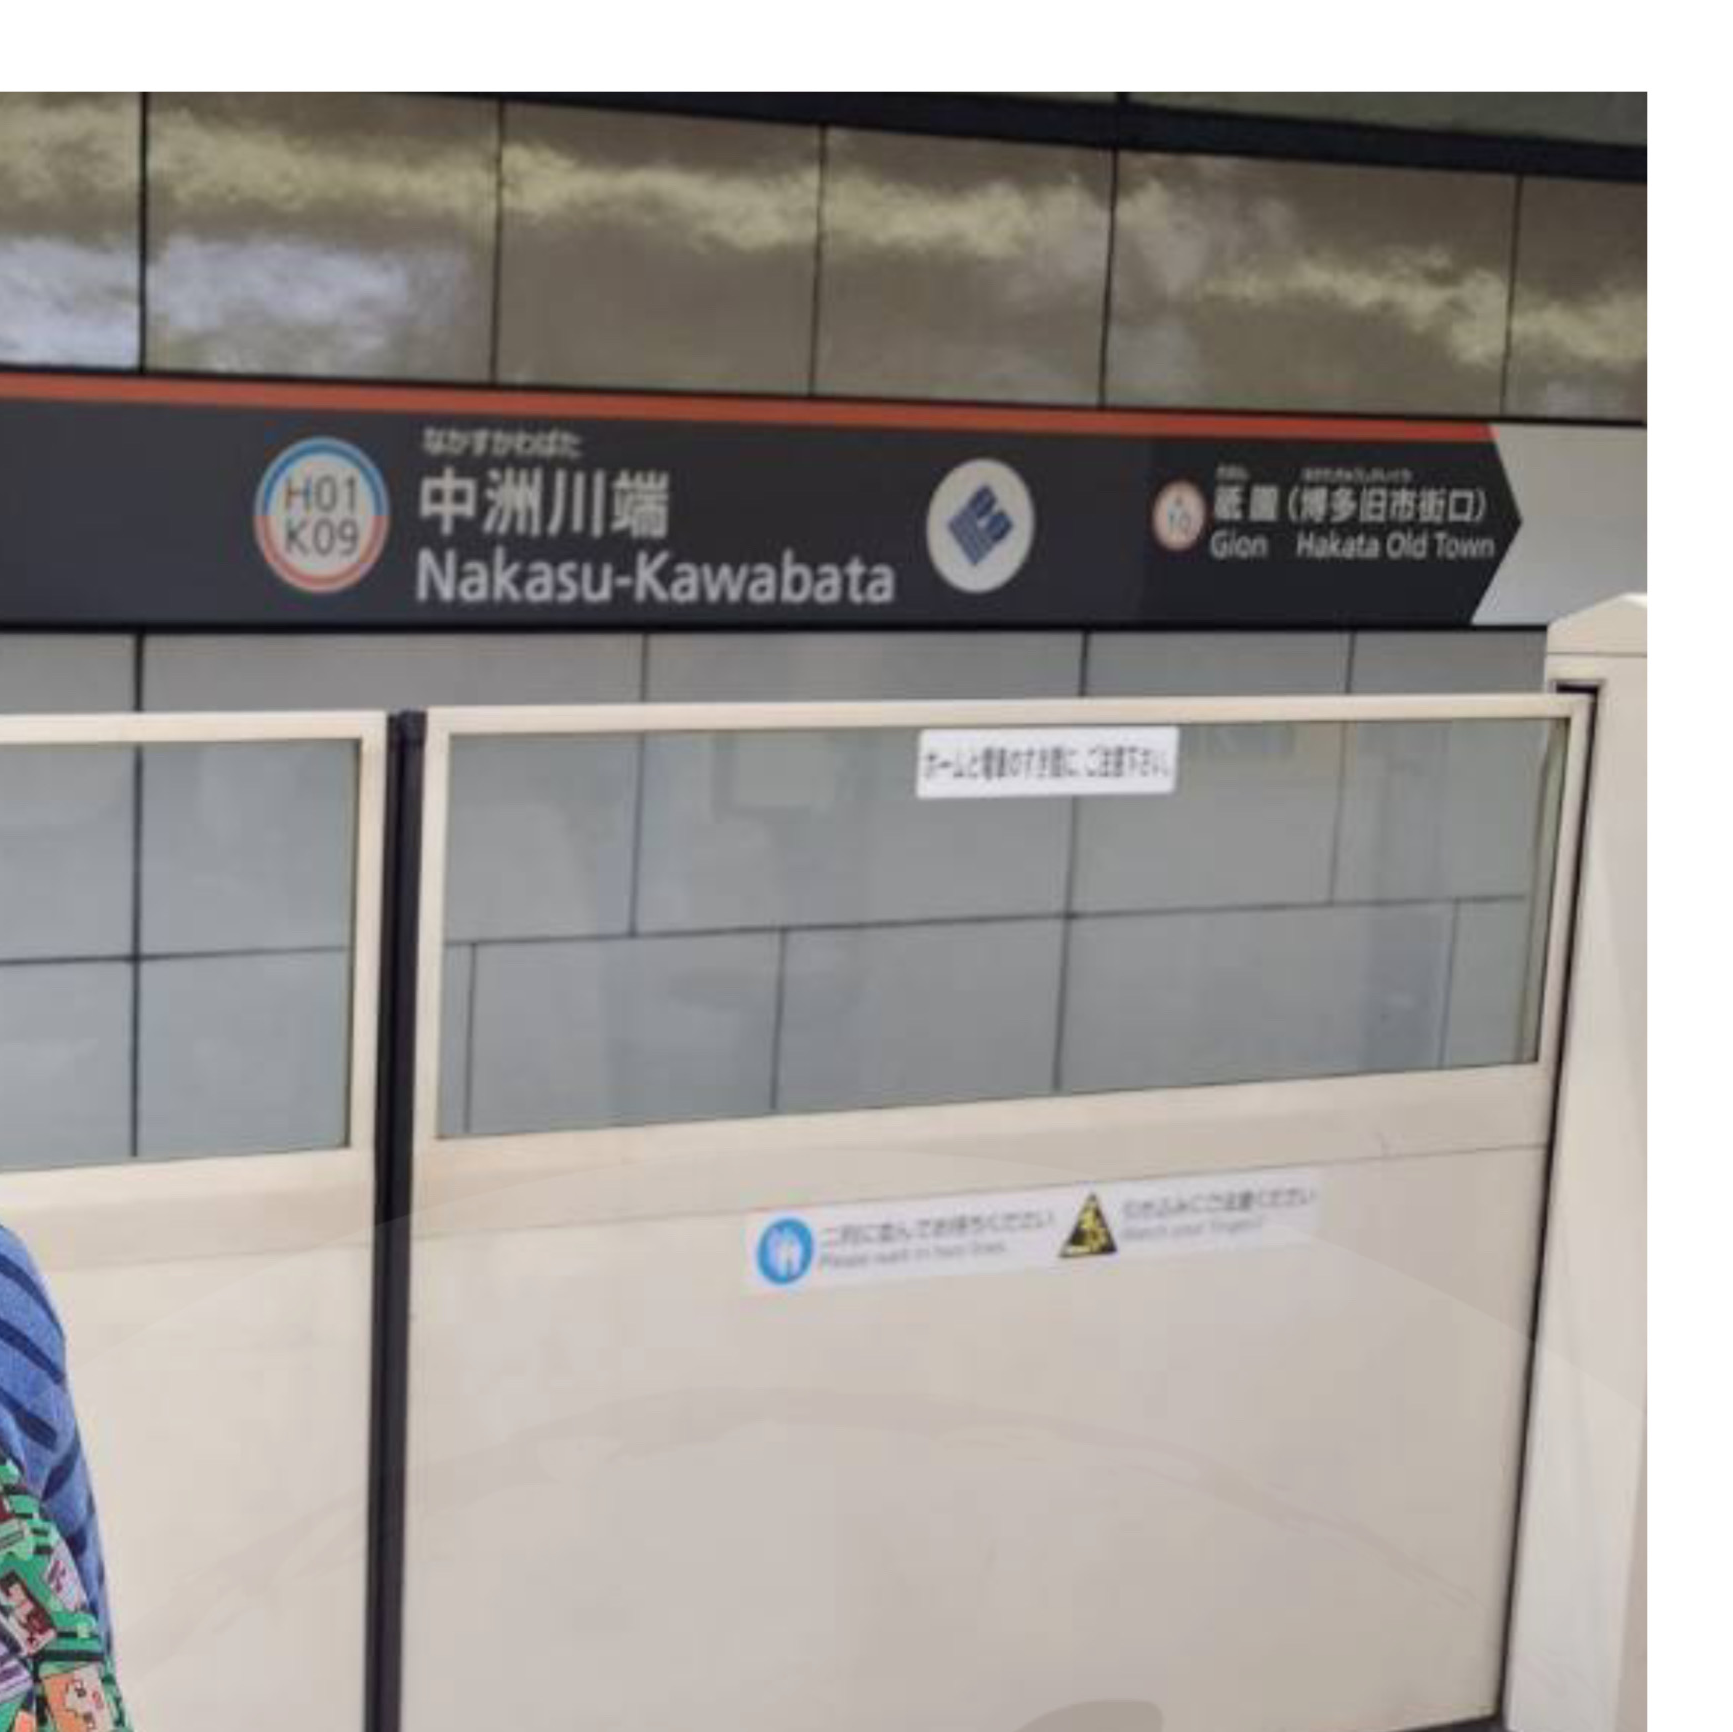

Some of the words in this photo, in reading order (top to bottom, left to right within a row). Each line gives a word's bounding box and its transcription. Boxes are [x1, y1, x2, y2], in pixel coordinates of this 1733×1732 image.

[284, 475, 357, 514] H01
[419, 466, 669, 538] 中洲川端
[284, 517, 360, 558] K09
[1210, 530, 1269, 560] Gion
[1296, 531, 1380, 559] Hakata
[1386, 530, 1427, 560] Old
[1433, 532, 1496, 560] Town
[415, 546, 896, 604] Nakasu-Kawabata
